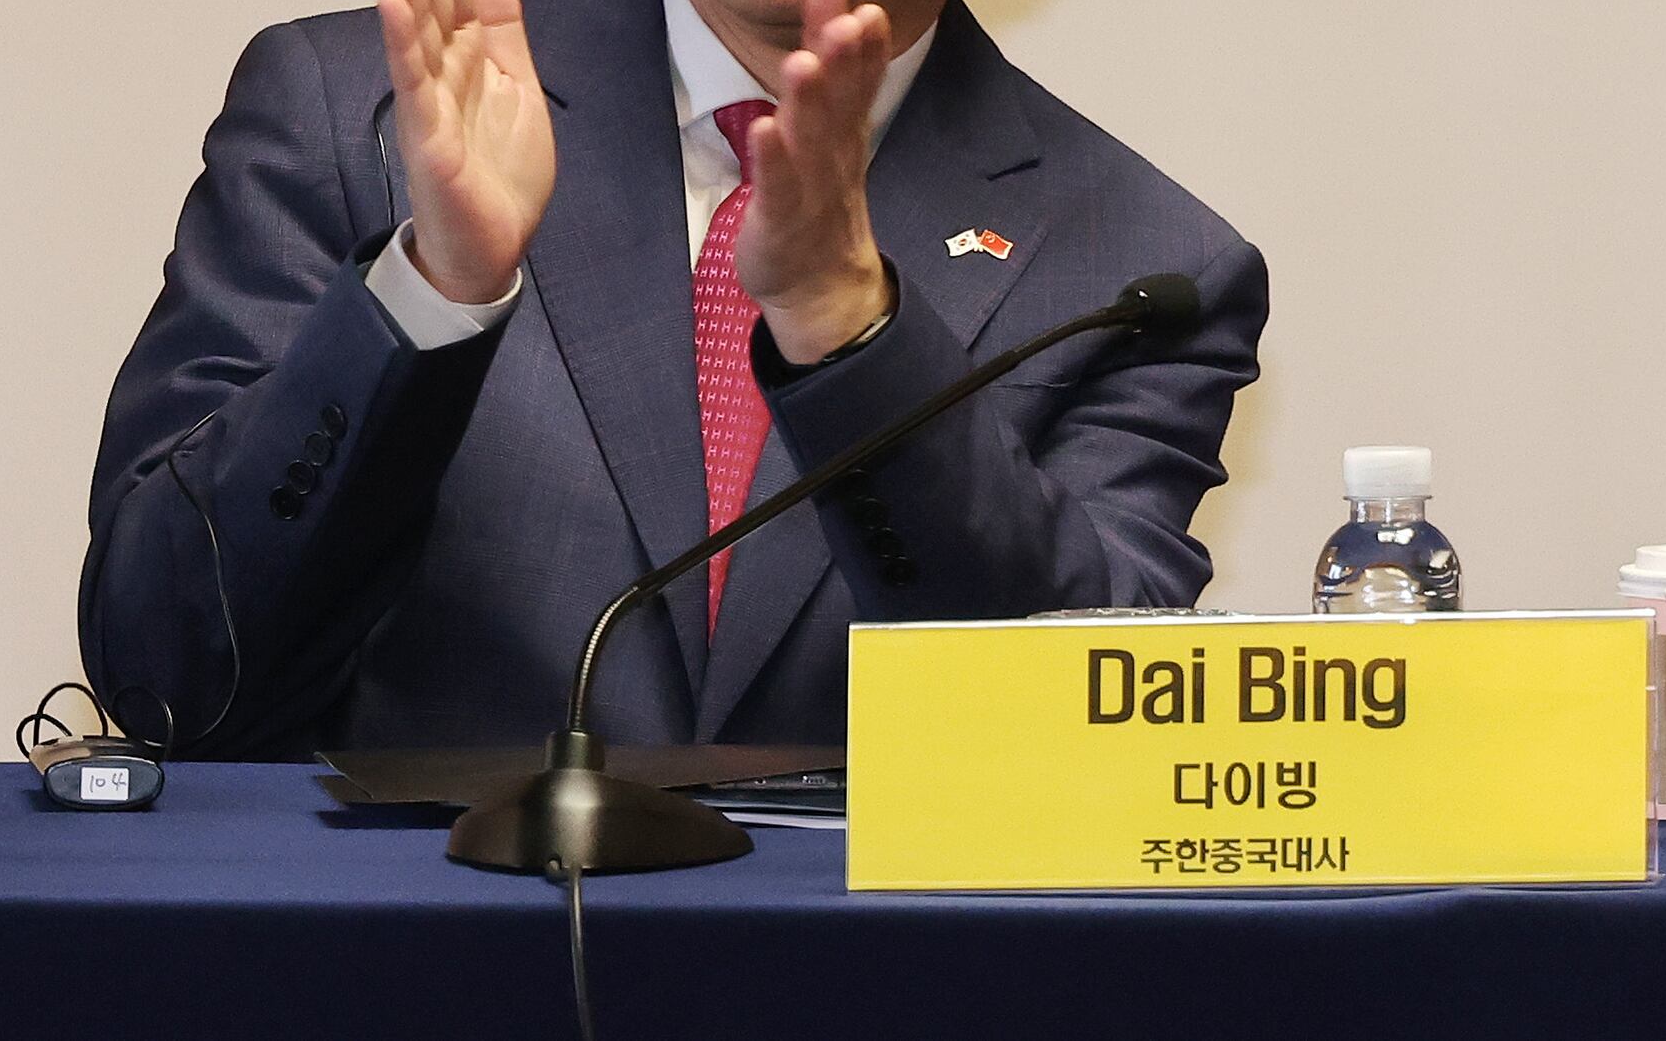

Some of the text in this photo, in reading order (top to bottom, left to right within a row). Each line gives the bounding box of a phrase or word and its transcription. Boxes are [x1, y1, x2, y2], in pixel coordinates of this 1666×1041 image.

[1088, 647, 1407, 729] Dai Bing
[1174, 761, 1317, 810] 다이빙
[1141, 836, 1350, 874] 주한중국대사
